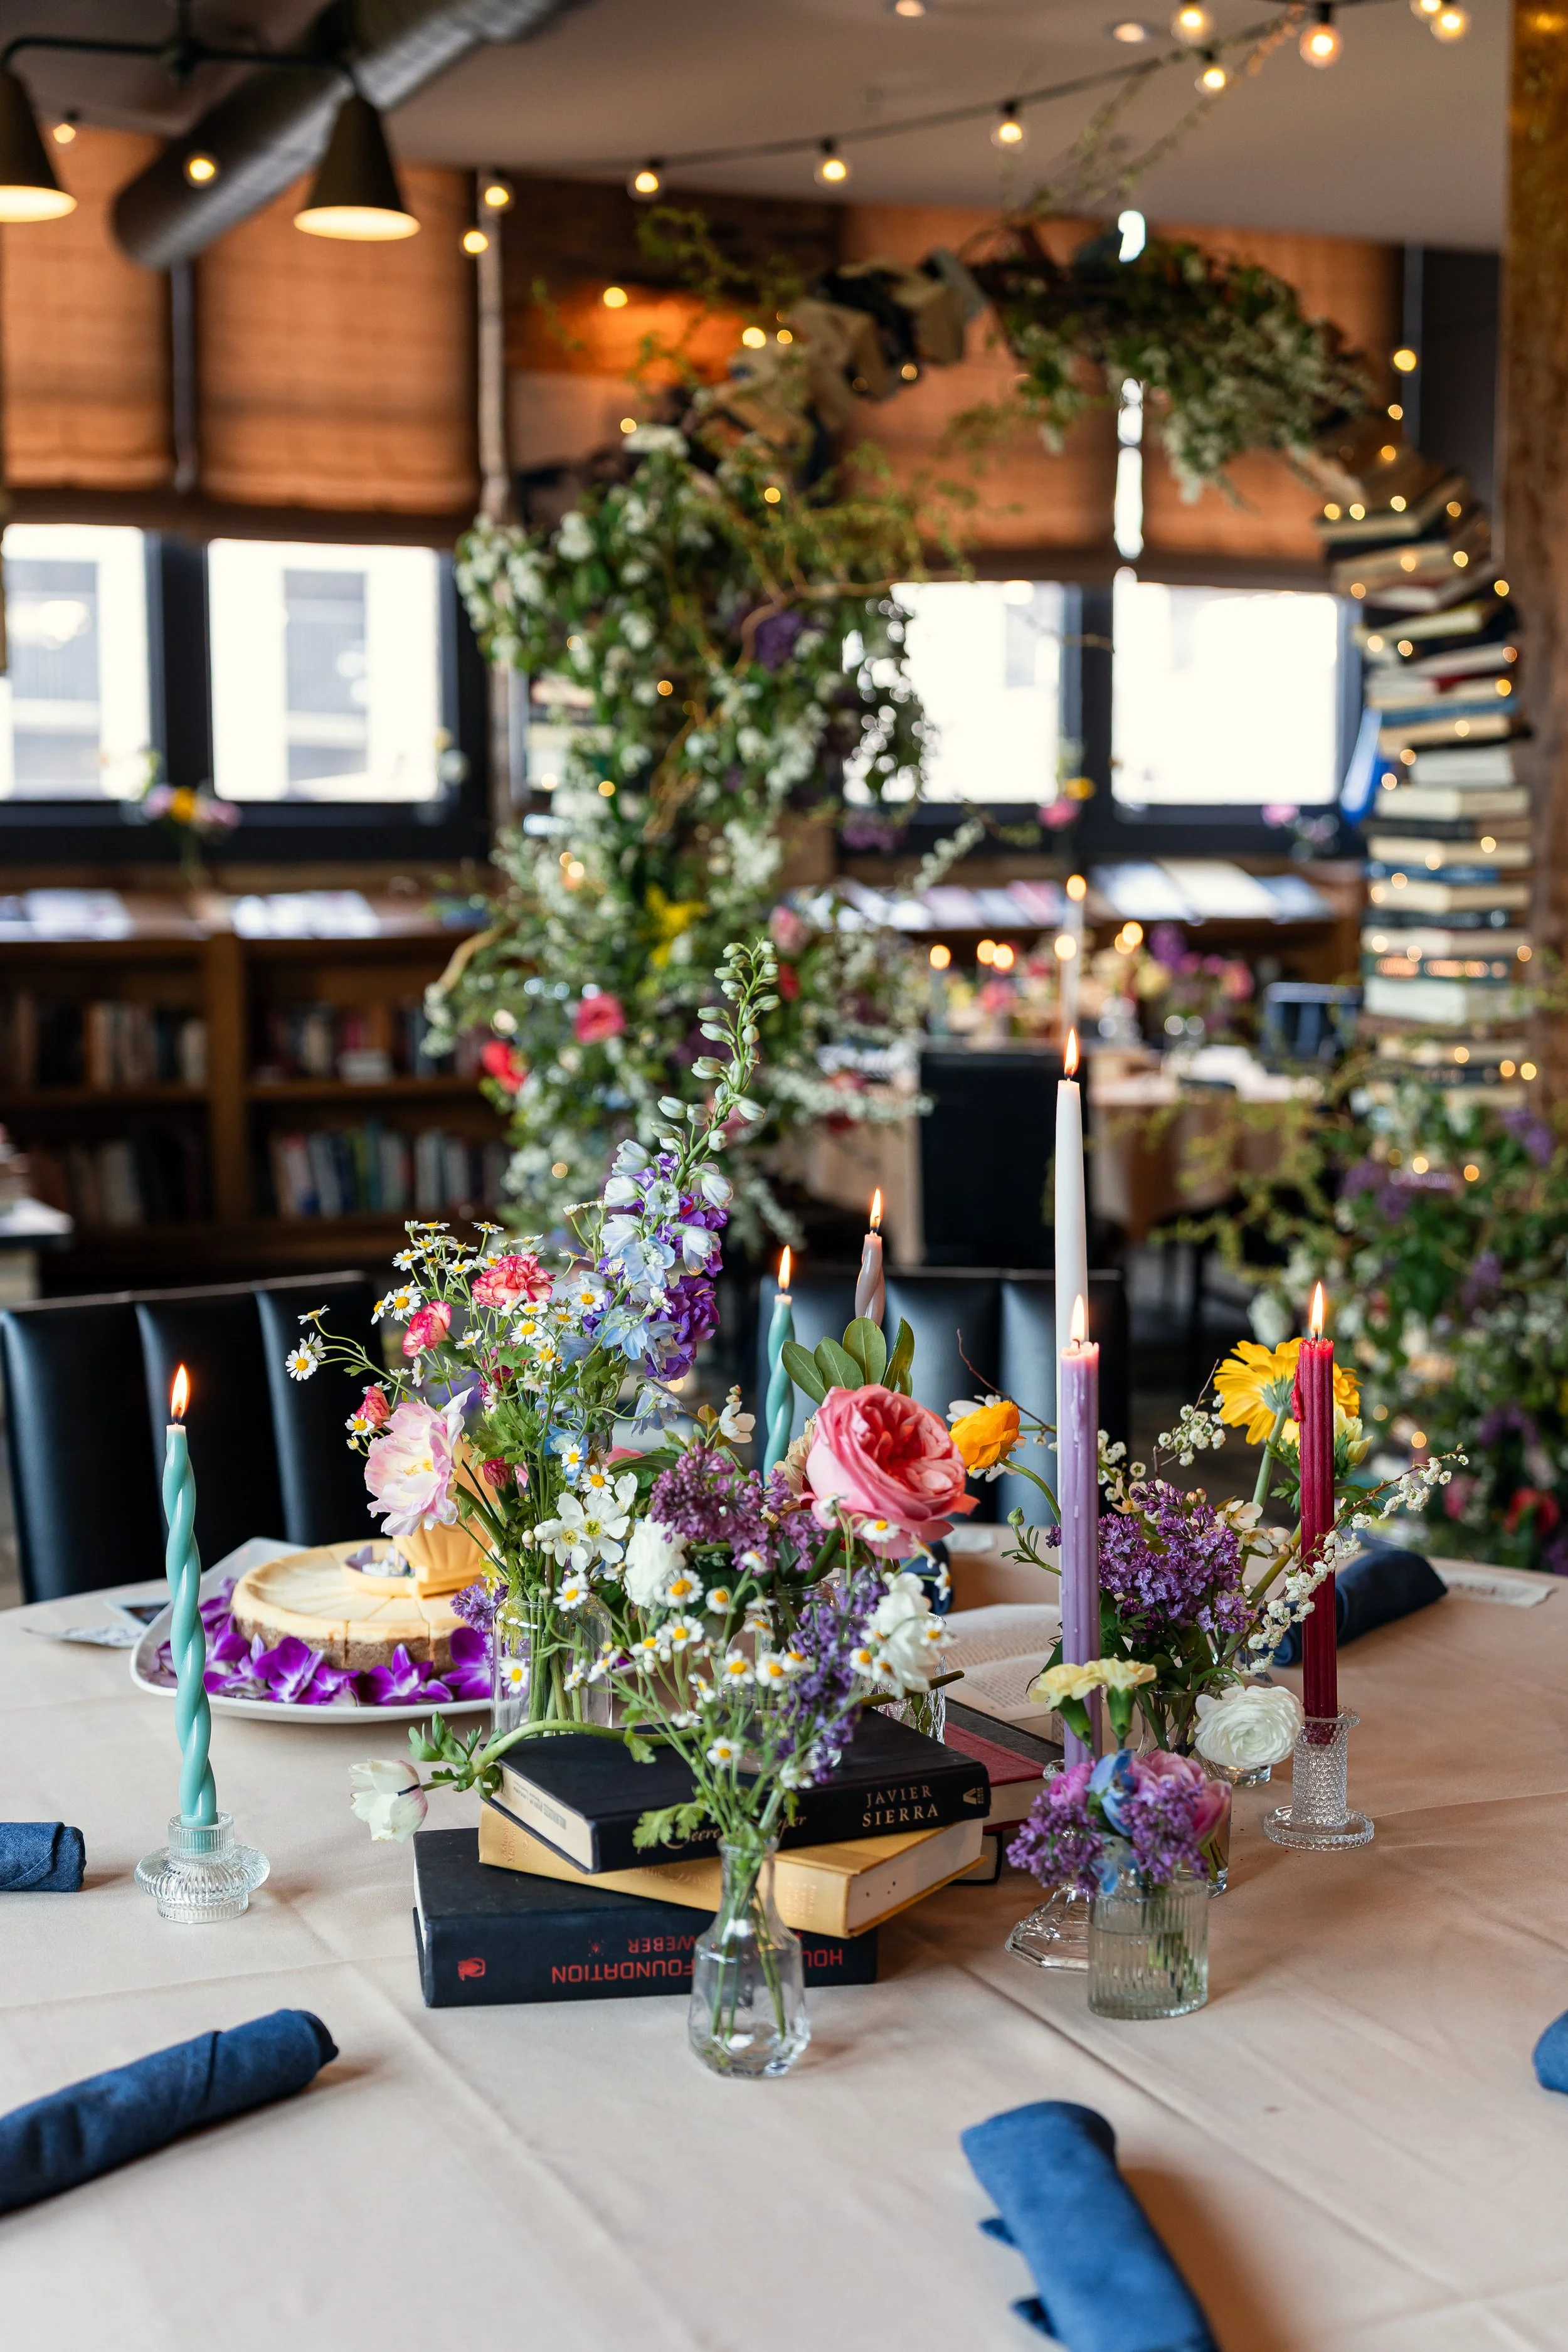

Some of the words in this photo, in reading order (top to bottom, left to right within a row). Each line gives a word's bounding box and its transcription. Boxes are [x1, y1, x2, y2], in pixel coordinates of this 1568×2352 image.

[866, 1785, 933, 1808] JAVIER
[862, 1803, 939, 1828] SIERRA
[627, 1935, 697, 1954] WEBER
[551, 1958, 696, 1984] FOUNDATION
